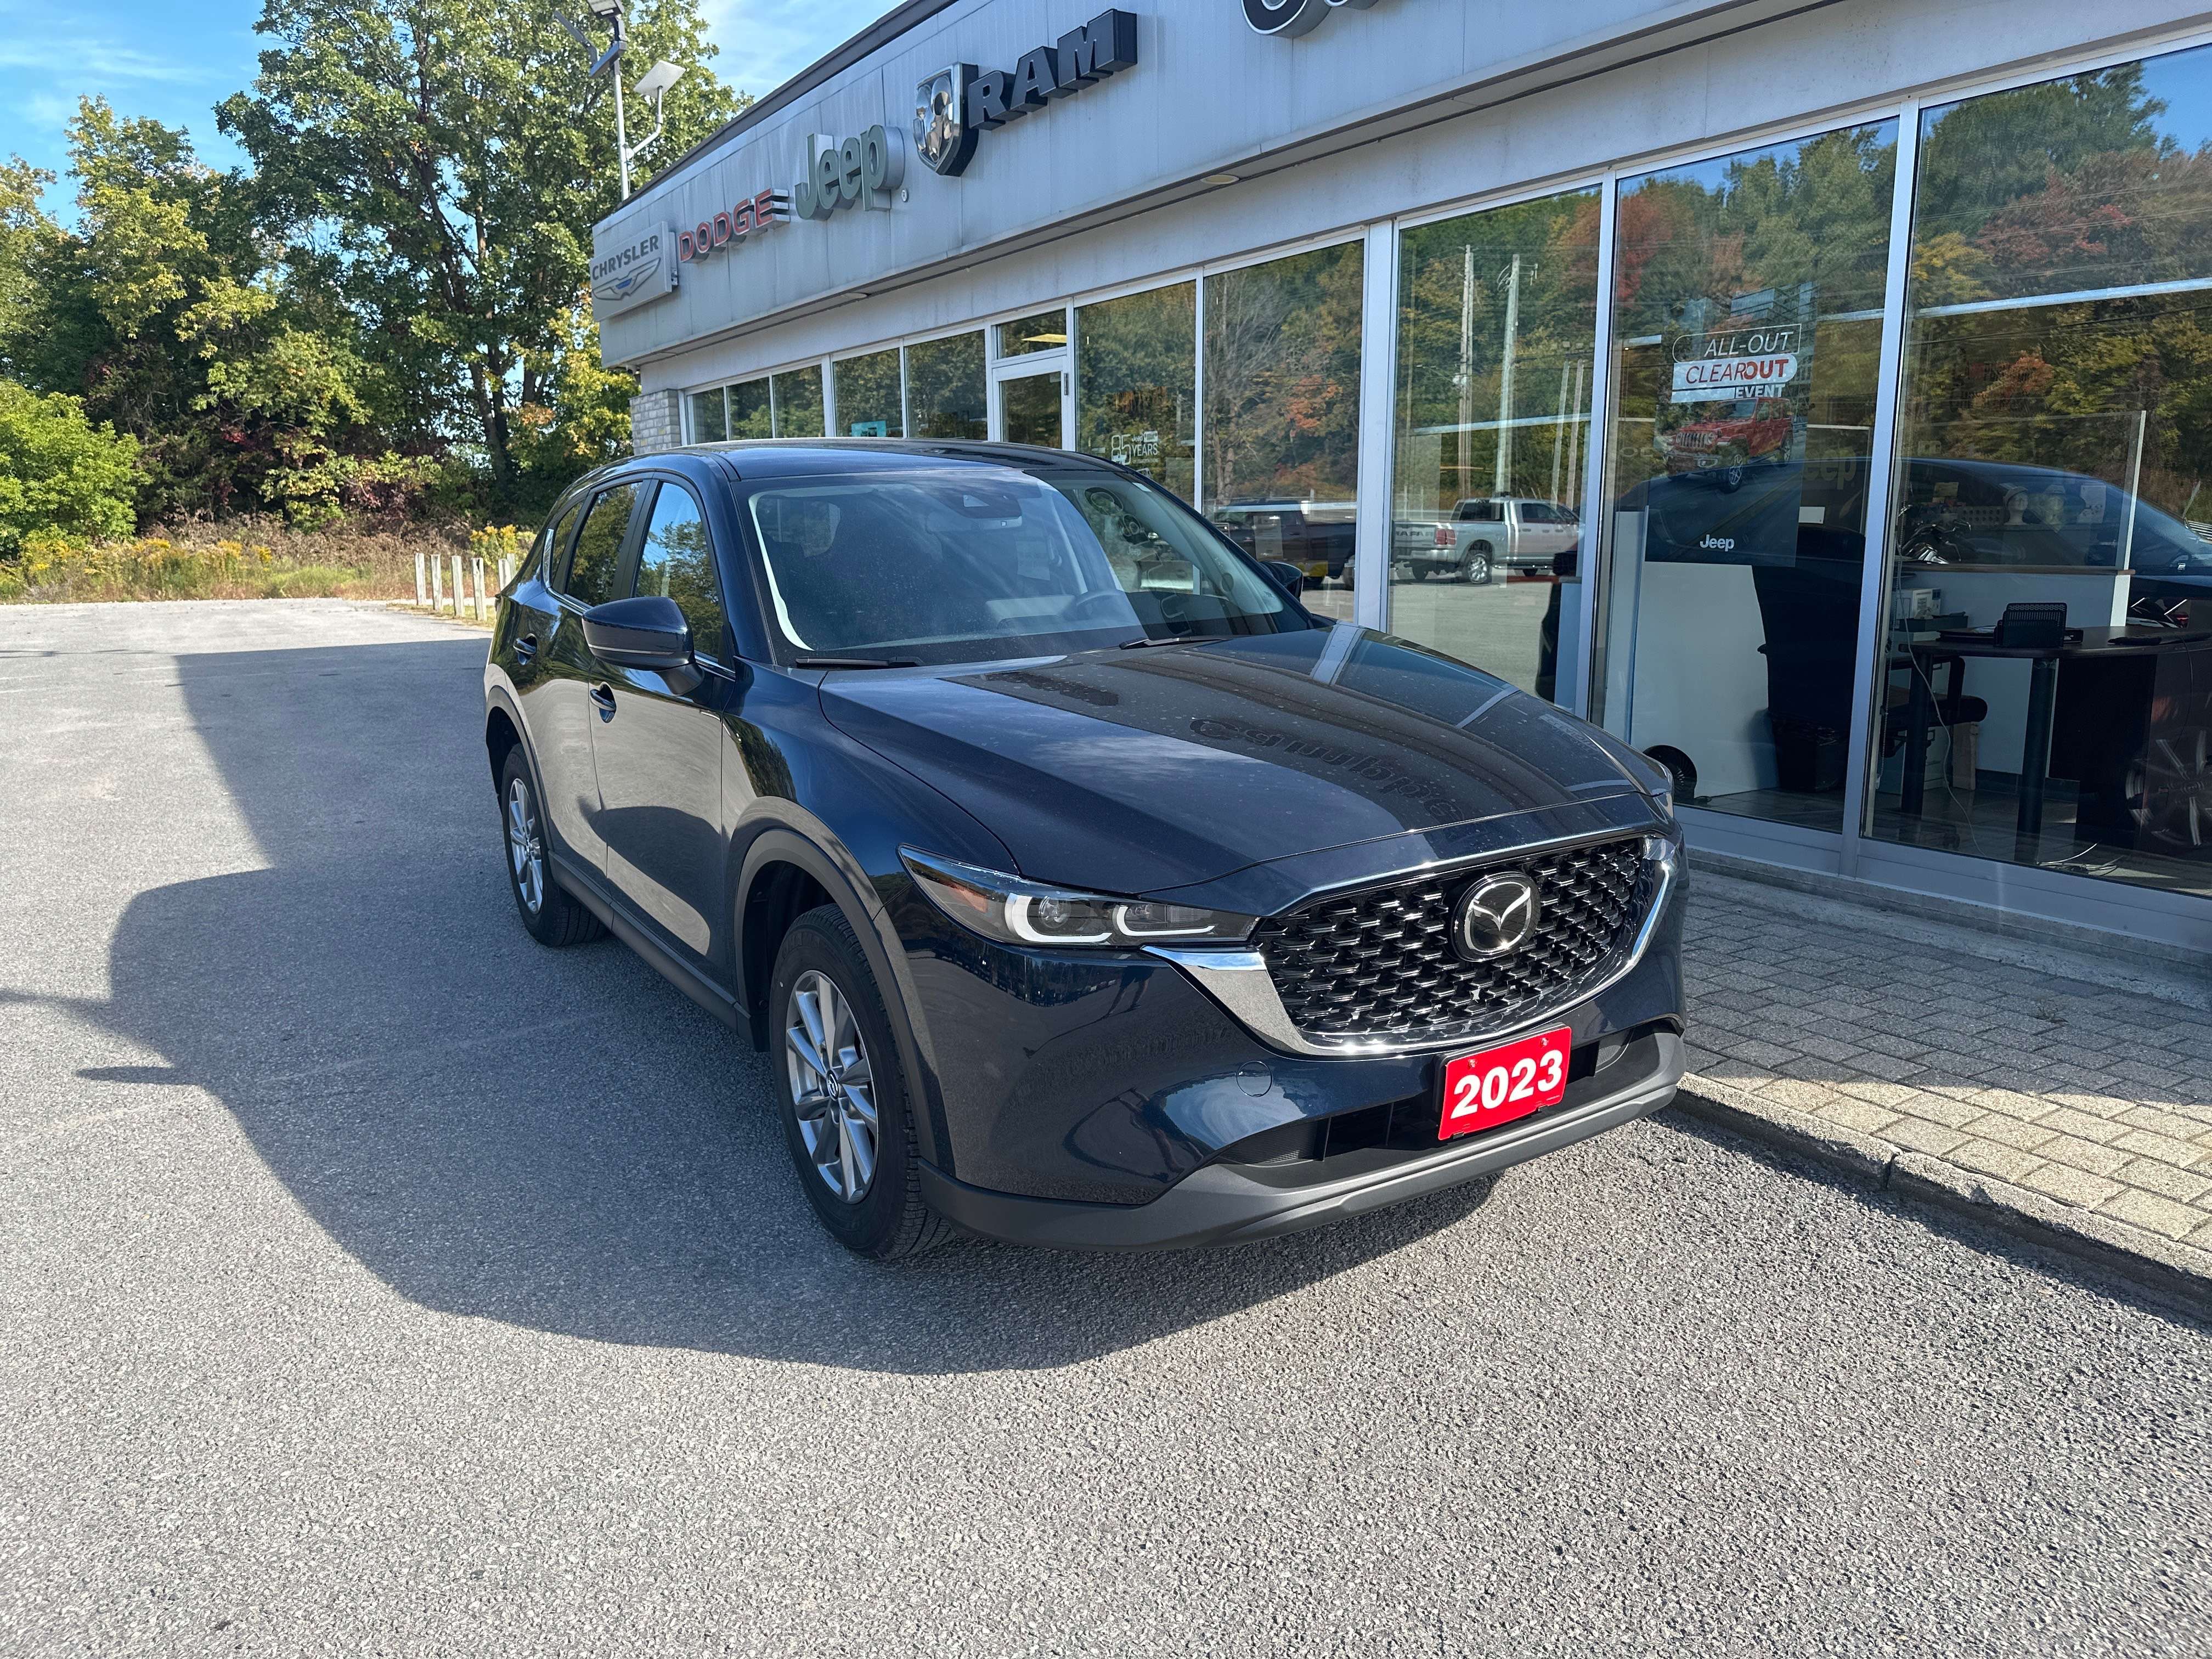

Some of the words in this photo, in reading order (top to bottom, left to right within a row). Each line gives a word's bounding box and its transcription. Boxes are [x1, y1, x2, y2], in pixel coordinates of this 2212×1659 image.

[968, 8, 1122, 129] RAM
[794, 125, 895, 220] Jeep
[679, 188, 777, 263] DODGE
[592, 235, 659, 280] CHRYSLER
[1703, 331, 1794, 357] ALL-OUT
[1685, 358, 1789, 383] CLEAROUT
[1735, 384, 1785, 398] EVENT
[1131, 443, 1159, 456] YEARS
[1803, 447, 1857, 490] eep
[1700, 534, 1735, 551] Jeep
[1450, 1049, 1563, 1120] 2023
